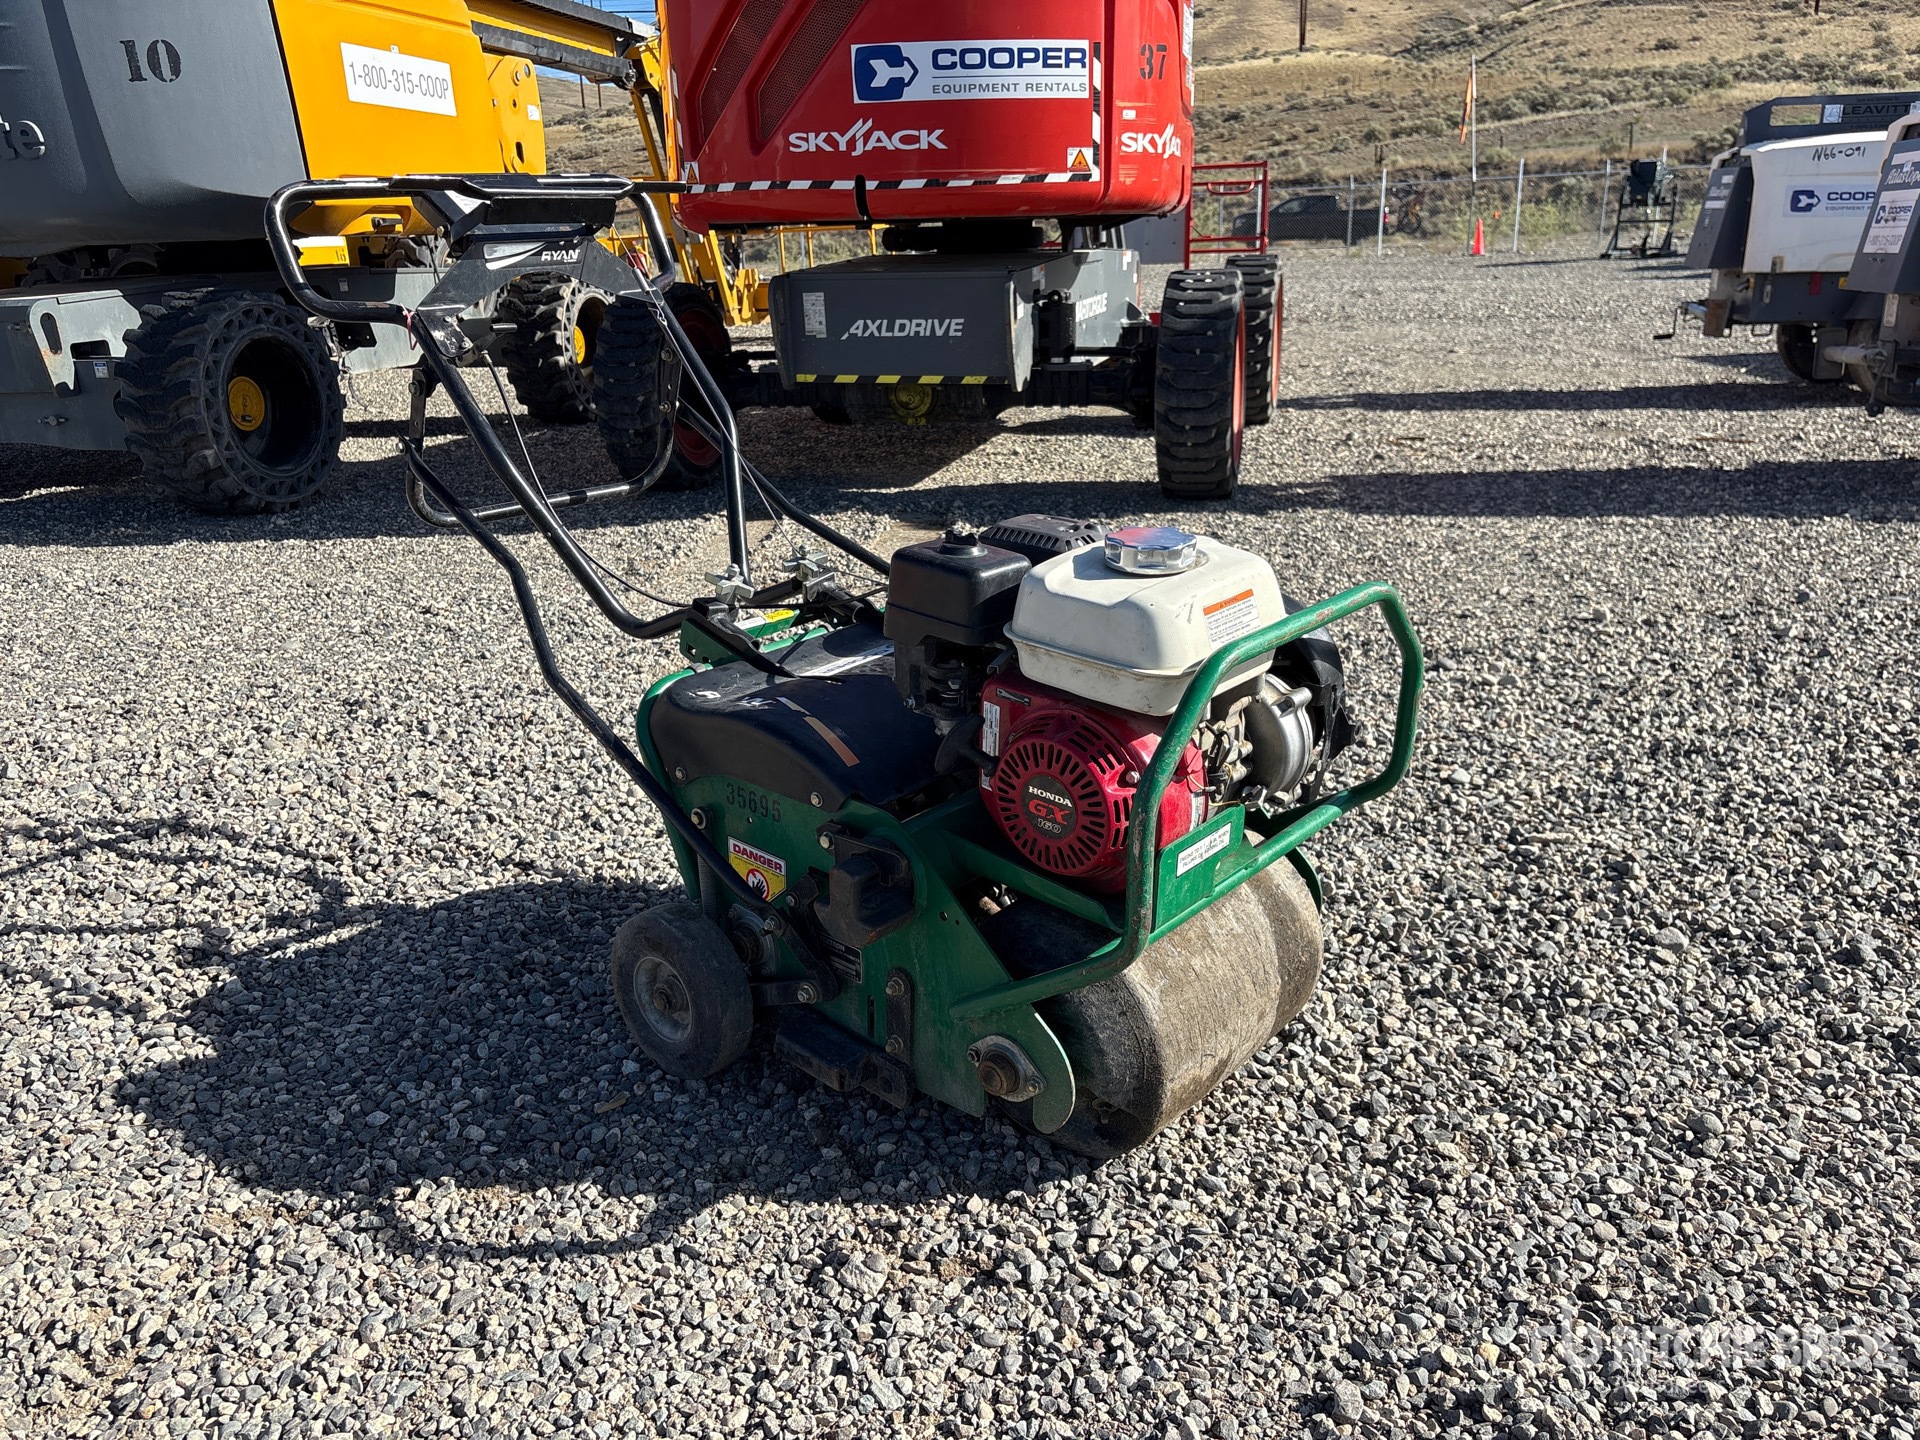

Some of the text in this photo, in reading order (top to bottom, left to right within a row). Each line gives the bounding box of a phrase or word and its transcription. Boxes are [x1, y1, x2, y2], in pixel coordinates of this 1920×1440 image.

[119, 39, 182, 83] 10
[931, 47, 1087, 70] COOPER
[1139, 43, 1168, 80] 37
[349, 61, 449, 100] 1-800-315-COOP
[932, 82, 1087, 94] EQUIPMENT RENTALS
[1842, 104, 1911, 116] LEAVITT
[788, 117, 948, 156] SKYJACK
[1827, 191, 1876, 201] COOP
[1887, 205, 1913, 215] COOPER
[541, 249, 579, 261] RYAN
[841, 318, 965, 341] AXLDRIVE
[726, 782, 782, 823] 35695
[1028, 785, 1073, 807] HONDA
[1028, 799, 1070, 825] GX
[732, 843, 783, 873] DANGER
